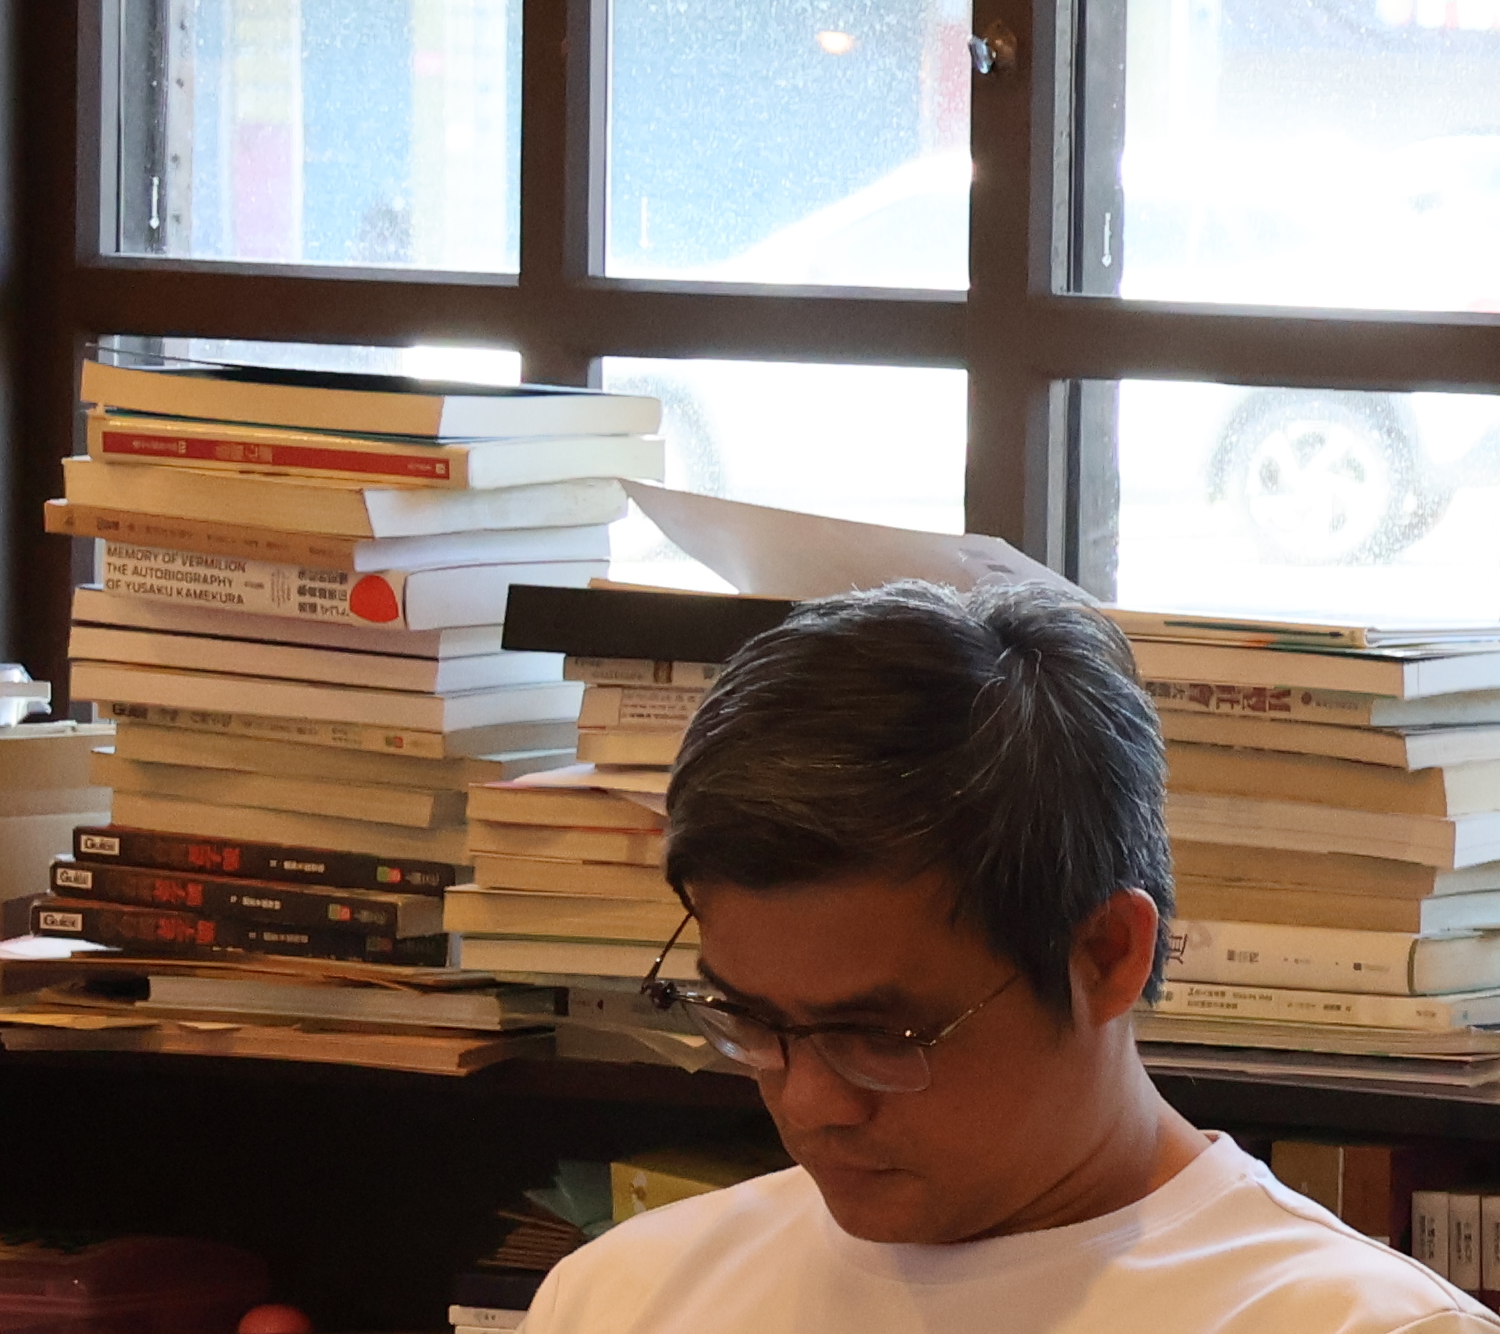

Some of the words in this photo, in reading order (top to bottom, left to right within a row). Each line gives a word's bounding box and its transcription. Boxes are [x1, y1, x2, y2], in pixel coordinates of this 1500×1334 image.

[106, 545, 161, 565] MEMORY
[163, 550, 179, 566] OF
[180, 553, 247, 574] VERMILION
[106, 562, 129, 578] THE
[131, 565, 235, 589] AUTOBIOGRAPHY
[106, 578, 122, 592] OF
[125, 581, 174, 599] YUSAKU
[175, 586, 245, 607] KAMEKURA
